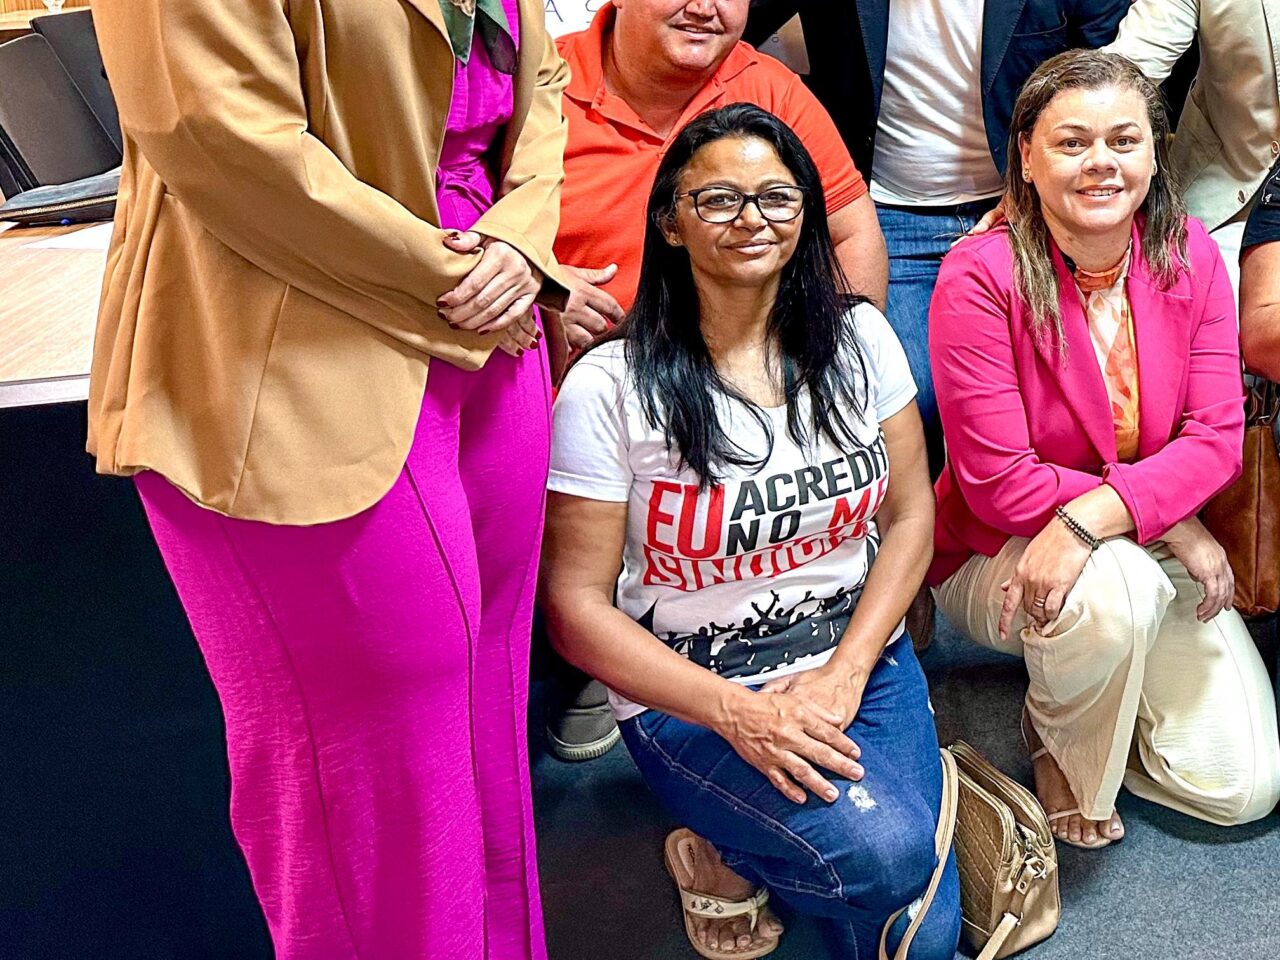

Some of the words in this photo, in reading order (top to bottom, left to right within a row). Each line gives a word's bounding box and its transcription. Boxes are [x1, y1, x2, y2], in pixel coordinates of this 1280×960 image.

[646, 479, 726, 560] EU
[729, 428, 889, 522] ACREDIT
[725, 509, 803, 557] NO
